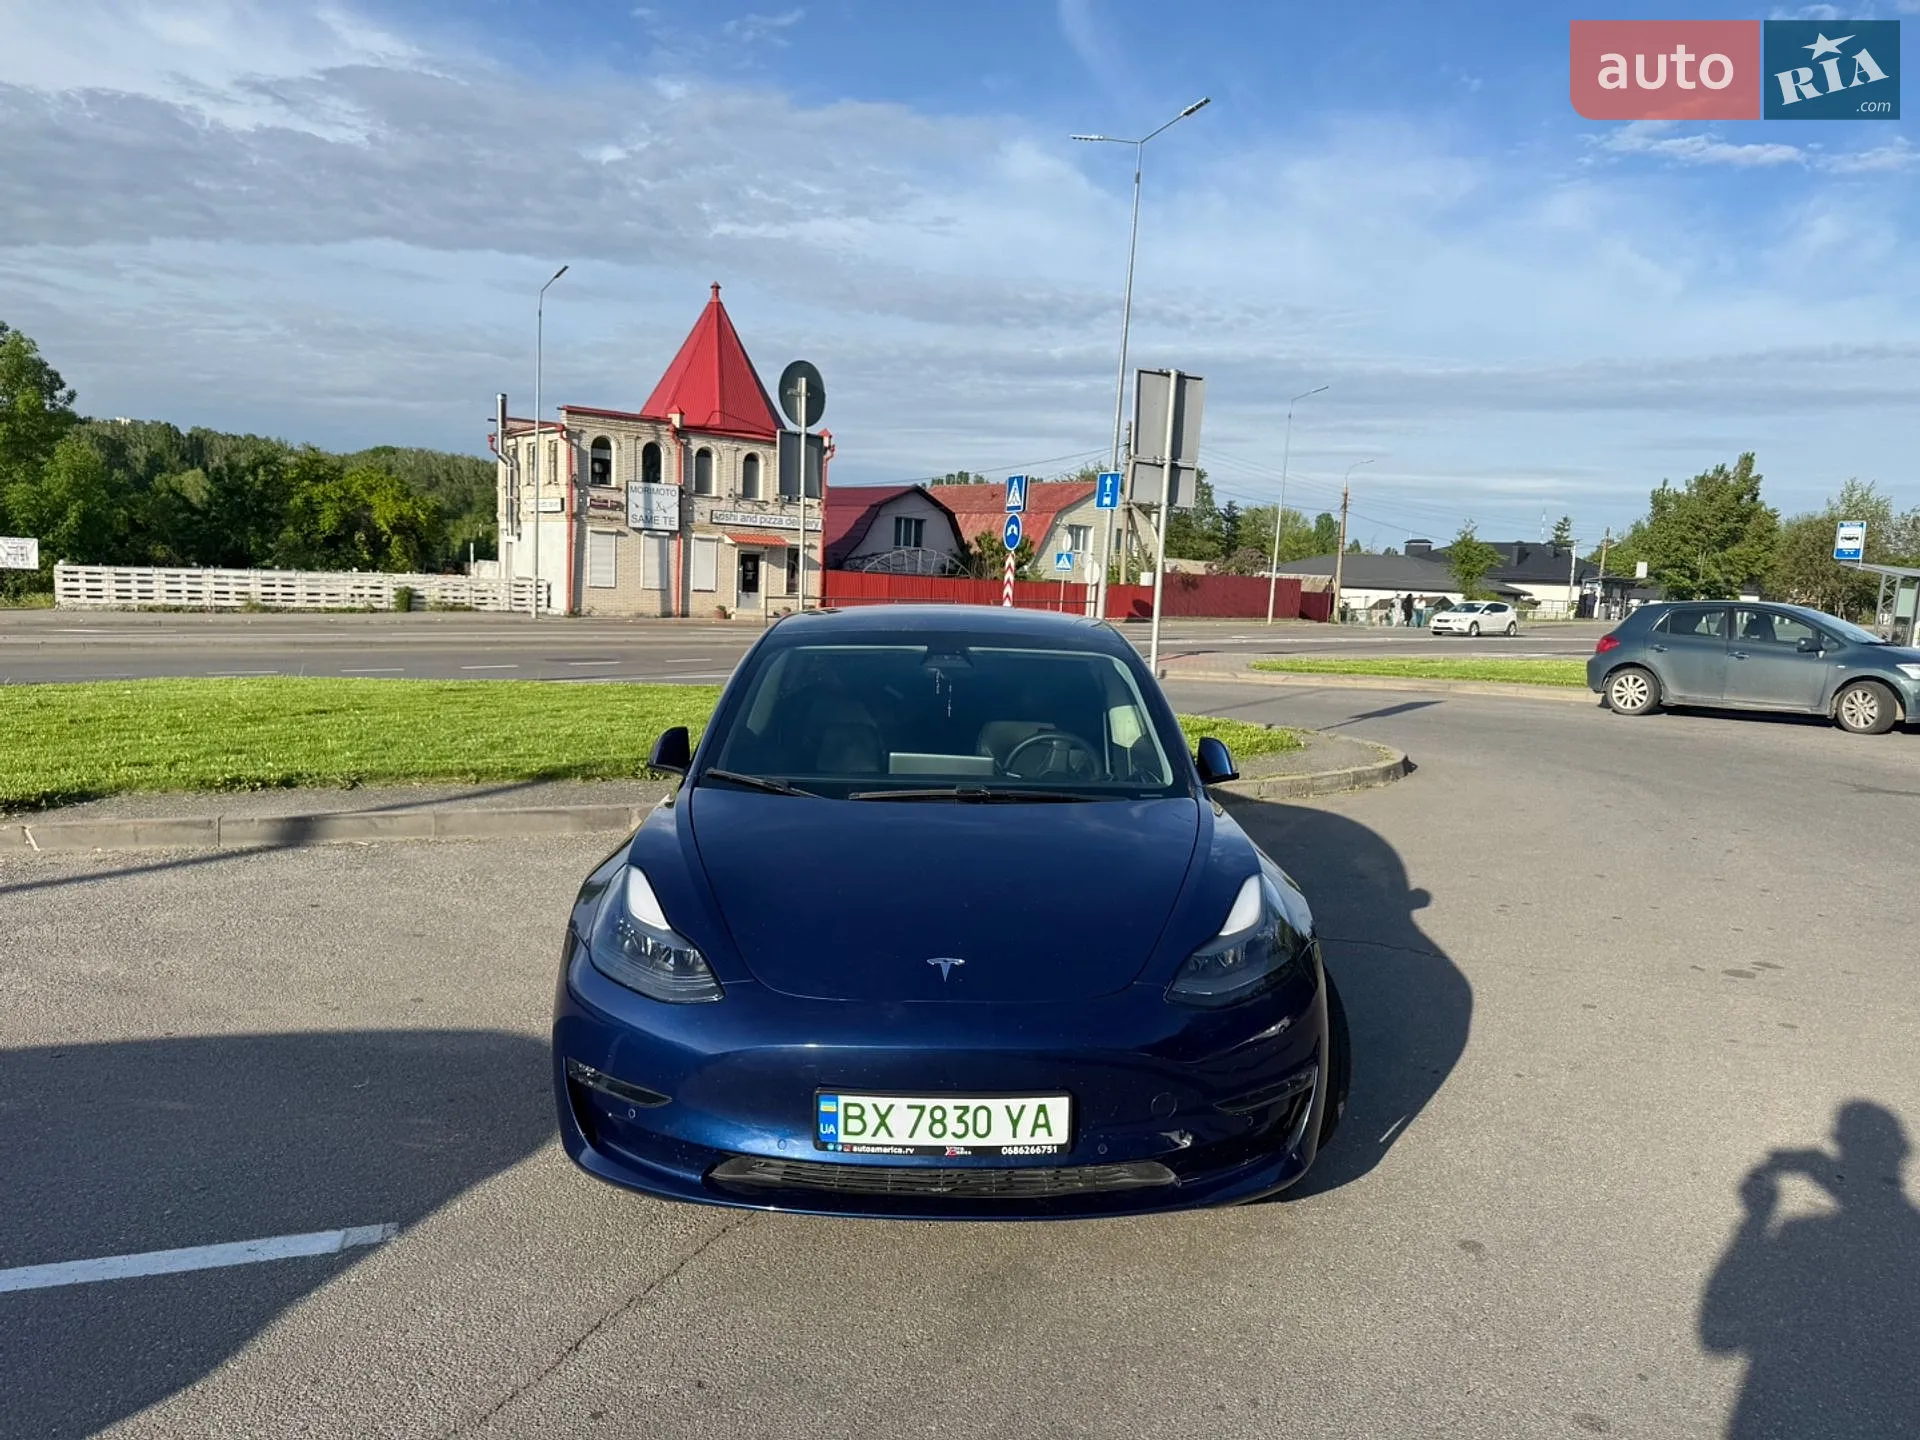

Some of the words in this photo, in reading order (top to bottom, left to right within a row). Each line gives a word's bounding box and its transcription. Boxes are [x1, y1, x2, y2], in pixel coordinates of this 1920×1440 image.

[630, 485, 677, 497] MORIMOTO
[631, 512, 660, 526] SAME
[662, 515, 676, 527] TE
[740, 513, 758, 524] and
[759, 516, 783, 526] pizza
[842, 1102, 895, 1138] BX
[907, 1104, 992, 1139] 7830
[1004, 1103, 1053, 1138] YA
[820, 1123, 837, 1135] UA
[1001, 1145, 1058, 1155] 0686266751
